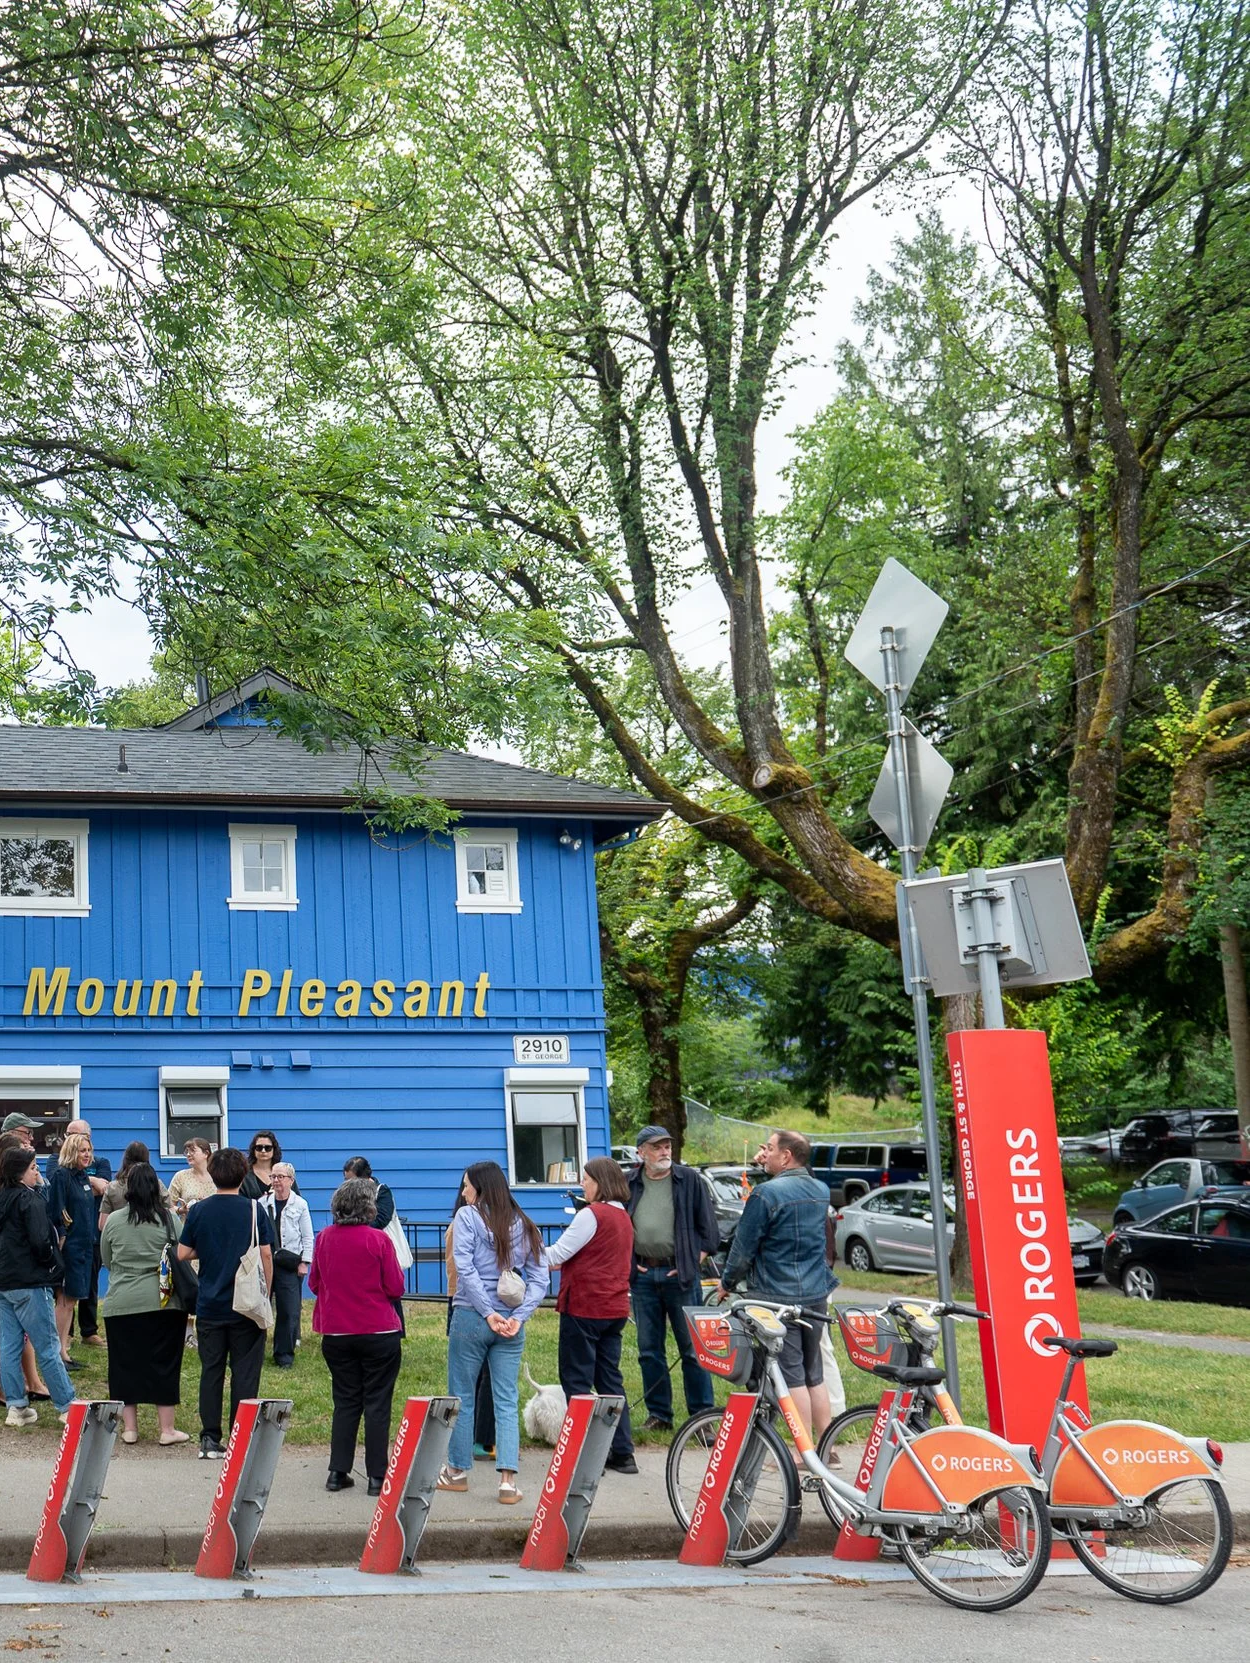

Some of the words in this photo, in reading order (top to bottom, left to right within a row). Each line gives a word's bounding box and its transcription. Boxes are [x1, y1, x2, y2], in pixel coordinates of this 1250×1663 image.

[22, 967, 204, 1017] Mount
[237, 969, 491, 1018] Pleasant
[521, 1039, 562, 1053] 2910
[953, 1061, 964, 1098] 13TH
[957, 1102, 966, 1113] &
[959, 1117, 968, 1134] ST
[961, 1139, 975, 1200] GEORGE
[1005, 1127, 1056, 1301] ROGERS
[705, 1357, 731, 1371] ROGERS
[784, 1411, 801, 1438] mobi
[865, 1408, 889, 1468] ROGERS
[221, 1420, 240, 1482] ROGERS
[950, 1456, 1014, 1473] ROGERS
[1122, 1449, 1190, 1464] ROGERS
[367, 1506, 384, 1549] mobi
[387, 1416, 409, 1478] ROGERS
[530, 1502, 547, 1547] mobi
[550, 1415, 574, 1477] ROGERS
[689, 1498, 707, 1541] mobi
[710, 1411, 734, 1472] ROGERS
